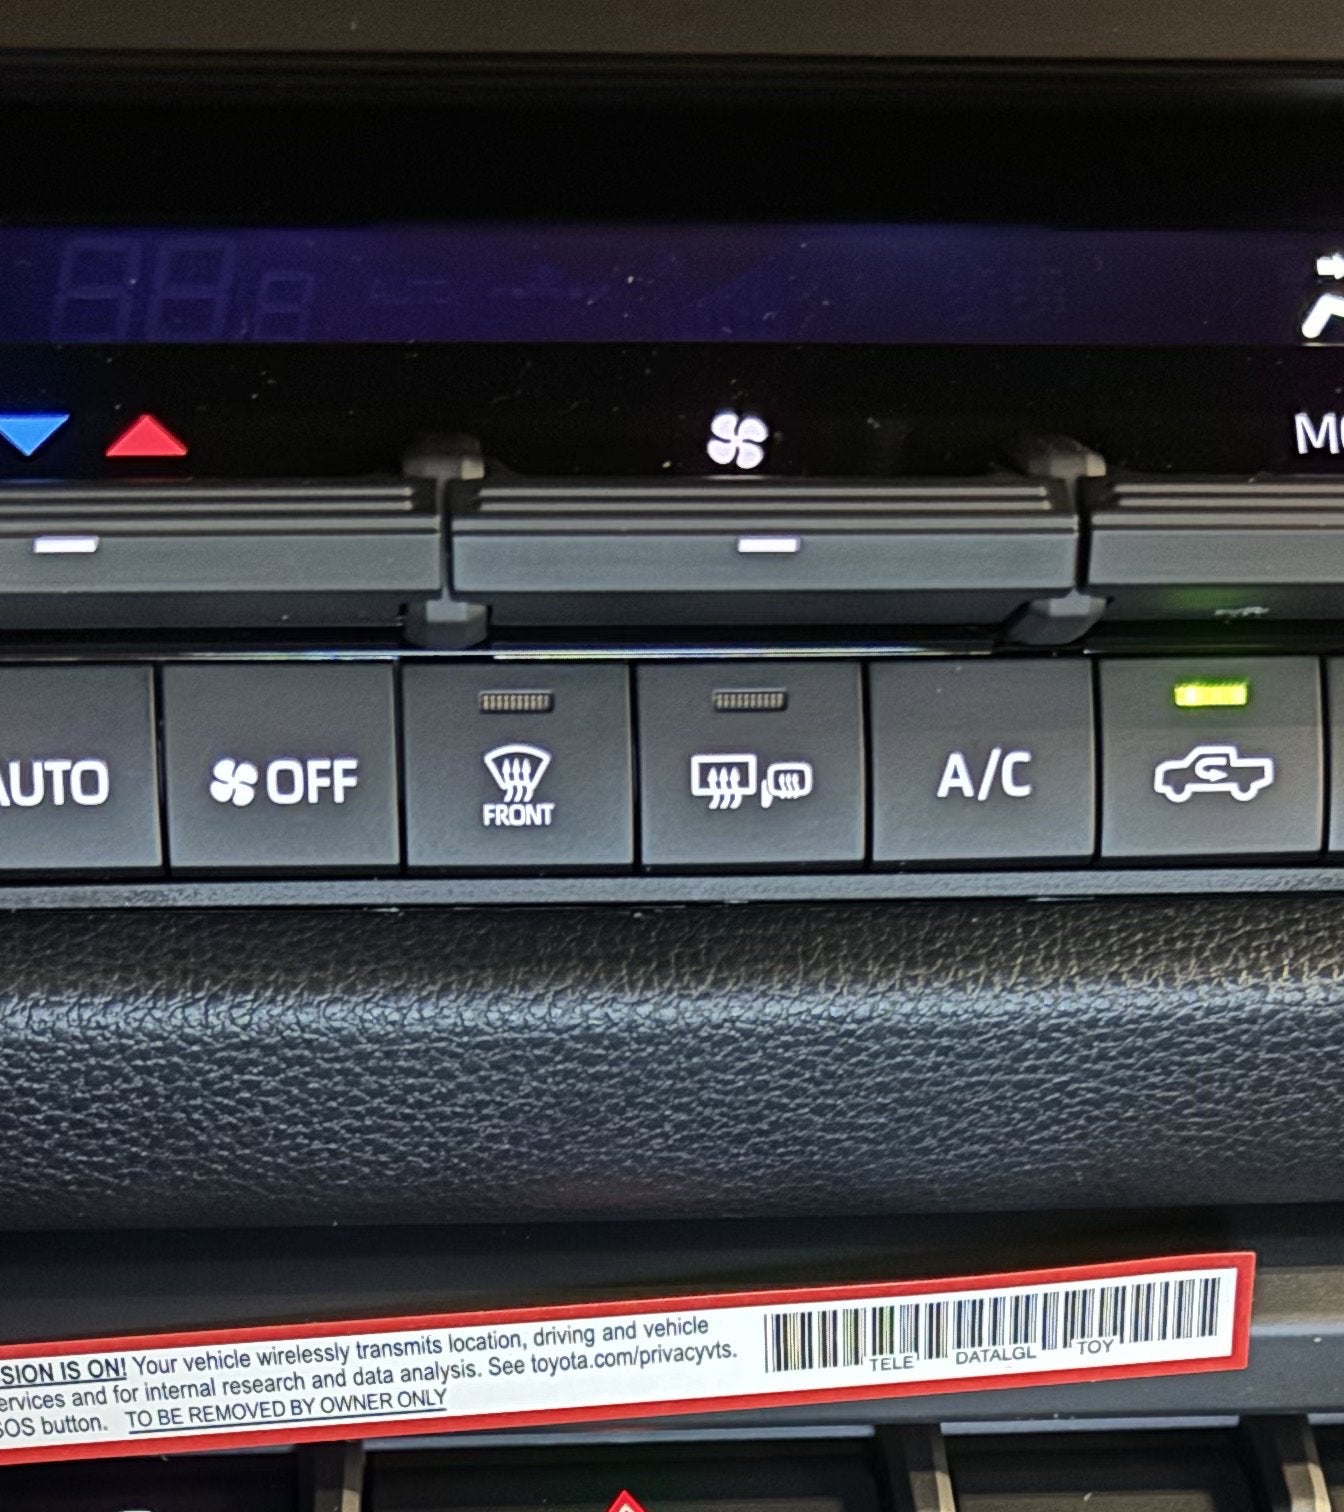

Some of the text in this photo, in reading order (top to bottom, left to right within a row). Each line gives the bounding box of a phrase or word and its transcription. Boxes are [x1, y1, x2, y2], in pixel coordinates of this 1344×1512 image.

[265, 758, 360, 805] OFF
[935, 747, 1033, 802] A/C
[482, 802, 556, 828] FRONT
[61, 1360, 80, 1380] IS
[88, 1357, 127, 1379] ON!
[132, 1353, 177, 1376] Your
[183, 1349, 251, 1373] vehicle
[256, 1341, 349, 1367] wirelessly
[355, 1335, 443, 1360] transmits
[449, 1331, 527, 1353] location,
[533, 1324, 595, 1348] driving
[602, 1320, 636, 1342] and
[643, 1316, 709, 1338] vehicle
[869, 1338, 1115, 1372] TELE DATALGL TOY
[71, 1386, 107, 1408] and
[113, 1384, 139, 1404] for
[144, 1377, 216, 1402] internal
[222, 1371, 306, 1396] research
[311, 1368, 347, 1391] and
[352, 1365, 394, 1387] data
[400, 1359, 483, 1384] analysis.
[488, 1356, 526, 1376] See
[531, 1341, 738, 1377] toyota.com/privacyvts.
[41, 1415, 107, 1436] button.
[125, 1388, 448, 1429] TO BE REMOVED BY OWNER ONLY
